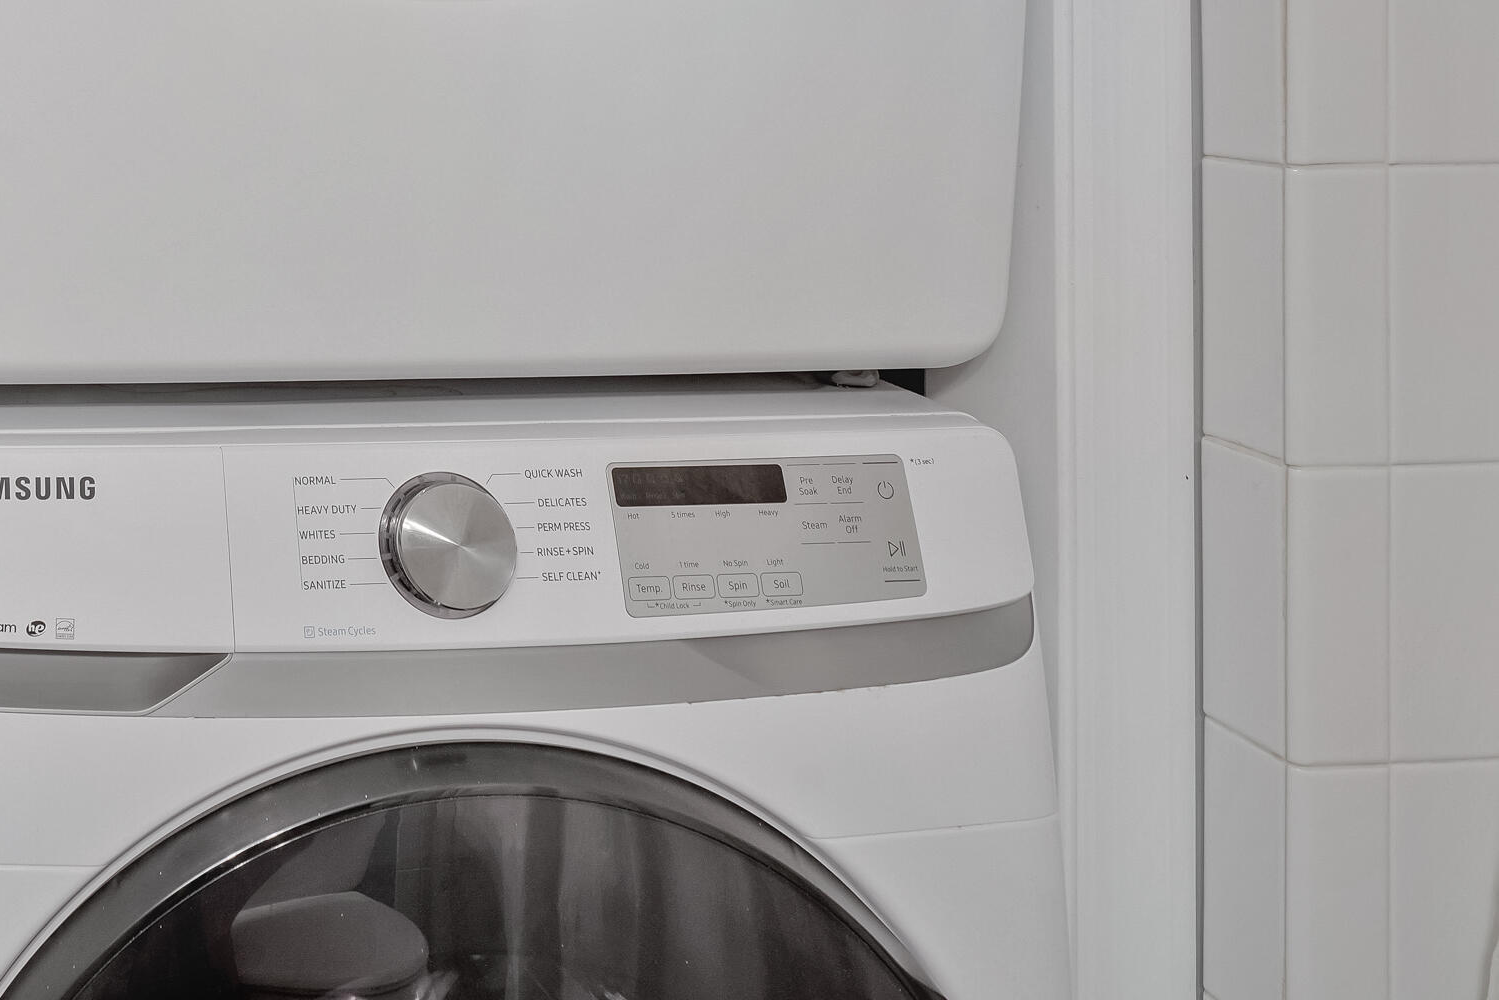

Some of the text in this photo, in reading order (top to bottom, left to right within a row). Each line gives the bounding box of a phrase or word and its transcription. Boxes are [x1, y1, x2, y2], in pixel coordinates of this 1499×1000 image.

[524, 468, 583, 479] QUICK WASH
[294, 475, 336, 485] NORMAL
[800, 476, 814, 485] Pre
[831, 475, 853, 485] Delay
[799, 487, 818, 496] Soak
[837, 486, 852, 495] End
[538, 497, 587, 507] DELICATES
[297, 504, 357, 515] HEAVY DUTY
[715, 510, 731, 519] High
[759, 509, 779, 518] Heavy
[627, 512, 640, 520] Hot
[676, 511, 696, 519] times
[838, 514, 862, 523] Alarm
[537, 521, 591, 531] PERM PRESS
[802, 521, 828, 530] Steam
[845, 525, 858, 534] Off
[299, 529, 336, 540] WHITES
[537, 546, 565, 556] RINSE
[572, 546, 594, 556] SPIN
[301, 555, 345, 565] BEDDING
[734, 559, 748, 568] Spin
[767, 558, 783, 567] Light
[634, 562, 649, 570] Cold
[542, 572, 564, 582] SELF
[303, 580, 347, 590] SANITIZE
[636, 584, 663, 593] Temp.
[682, 582, 706, 592] Rinse
[728, 581, 748, 591] Spin
[773, 579, 790, 589] Soil
[743, 600, 756, 608] Only
[28, 621, 46, 635] he
[318, 626, 376, 638] Steam Cycles
